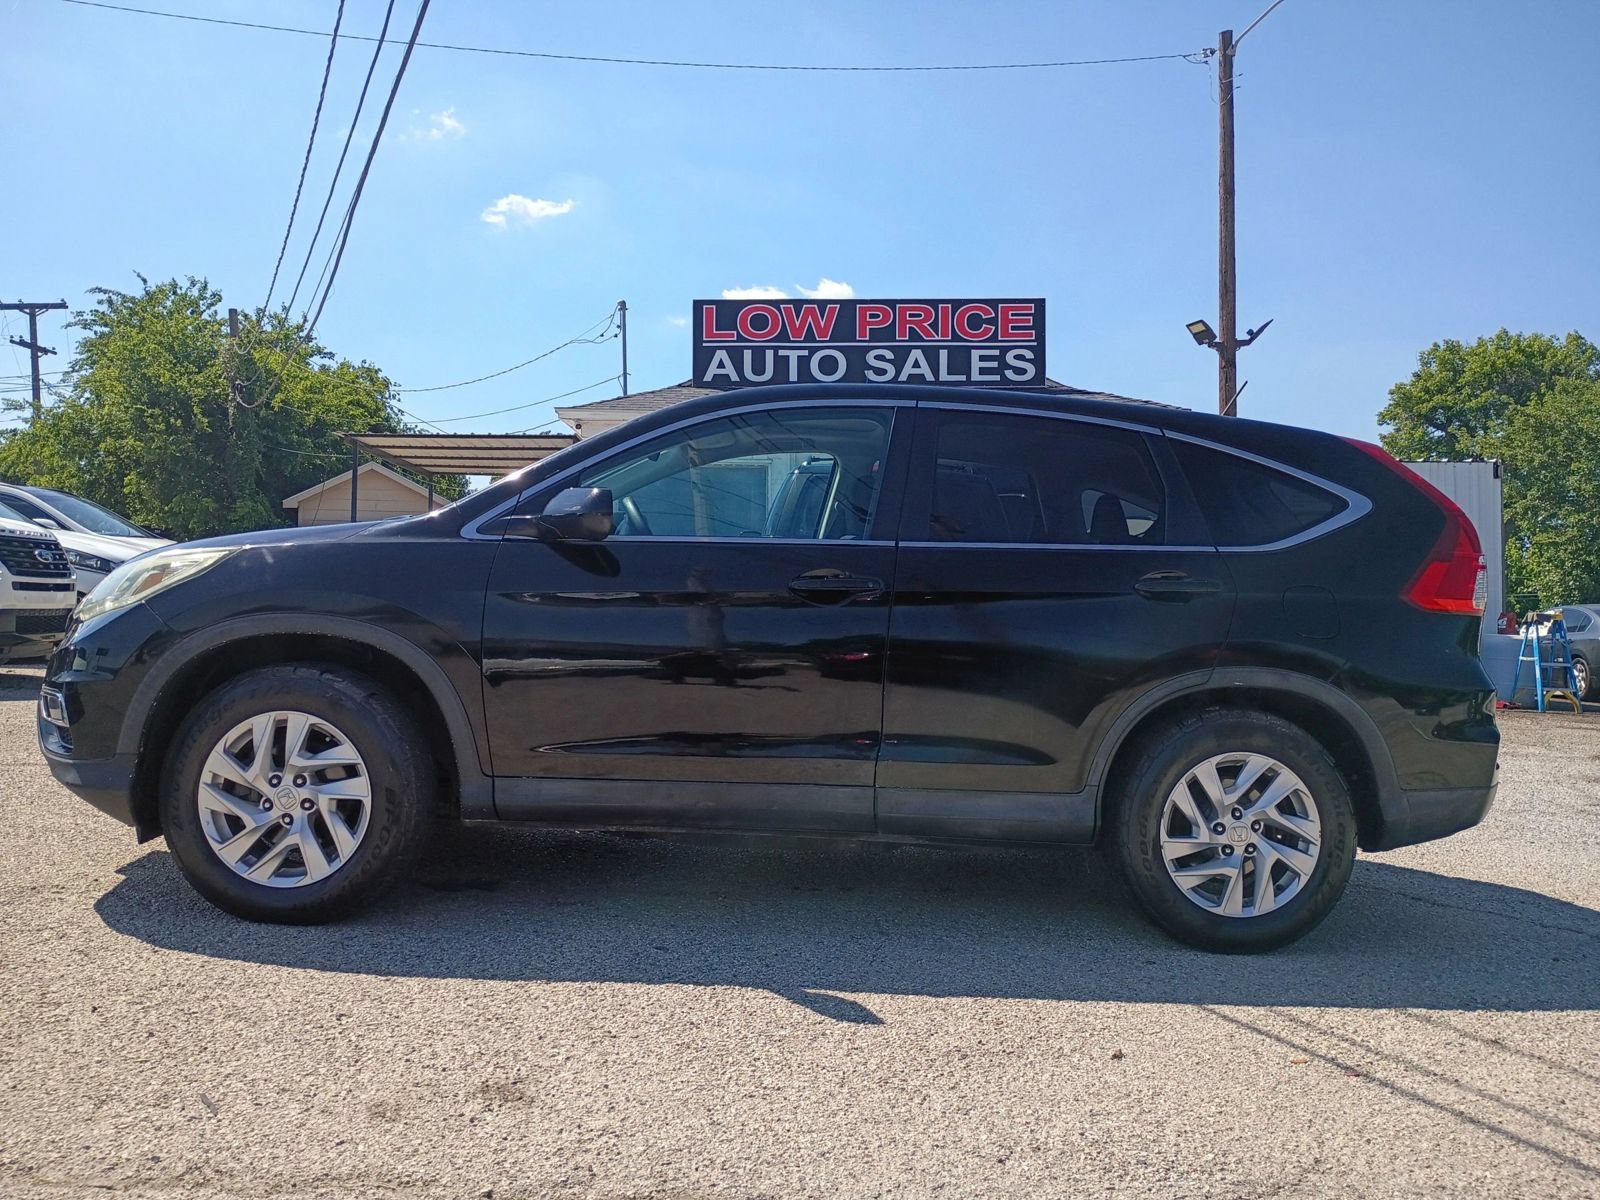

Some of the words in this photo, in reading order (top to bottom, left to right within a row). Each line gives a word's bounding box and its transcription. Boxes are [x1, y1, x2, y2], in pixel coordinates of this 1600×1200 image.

[702, 304, 840, 341] LOW
[856, 303, 1036, 341] PRICE
[703, 349, 847, 382] AUTO
[864, 349, 1036, 382] SALES
